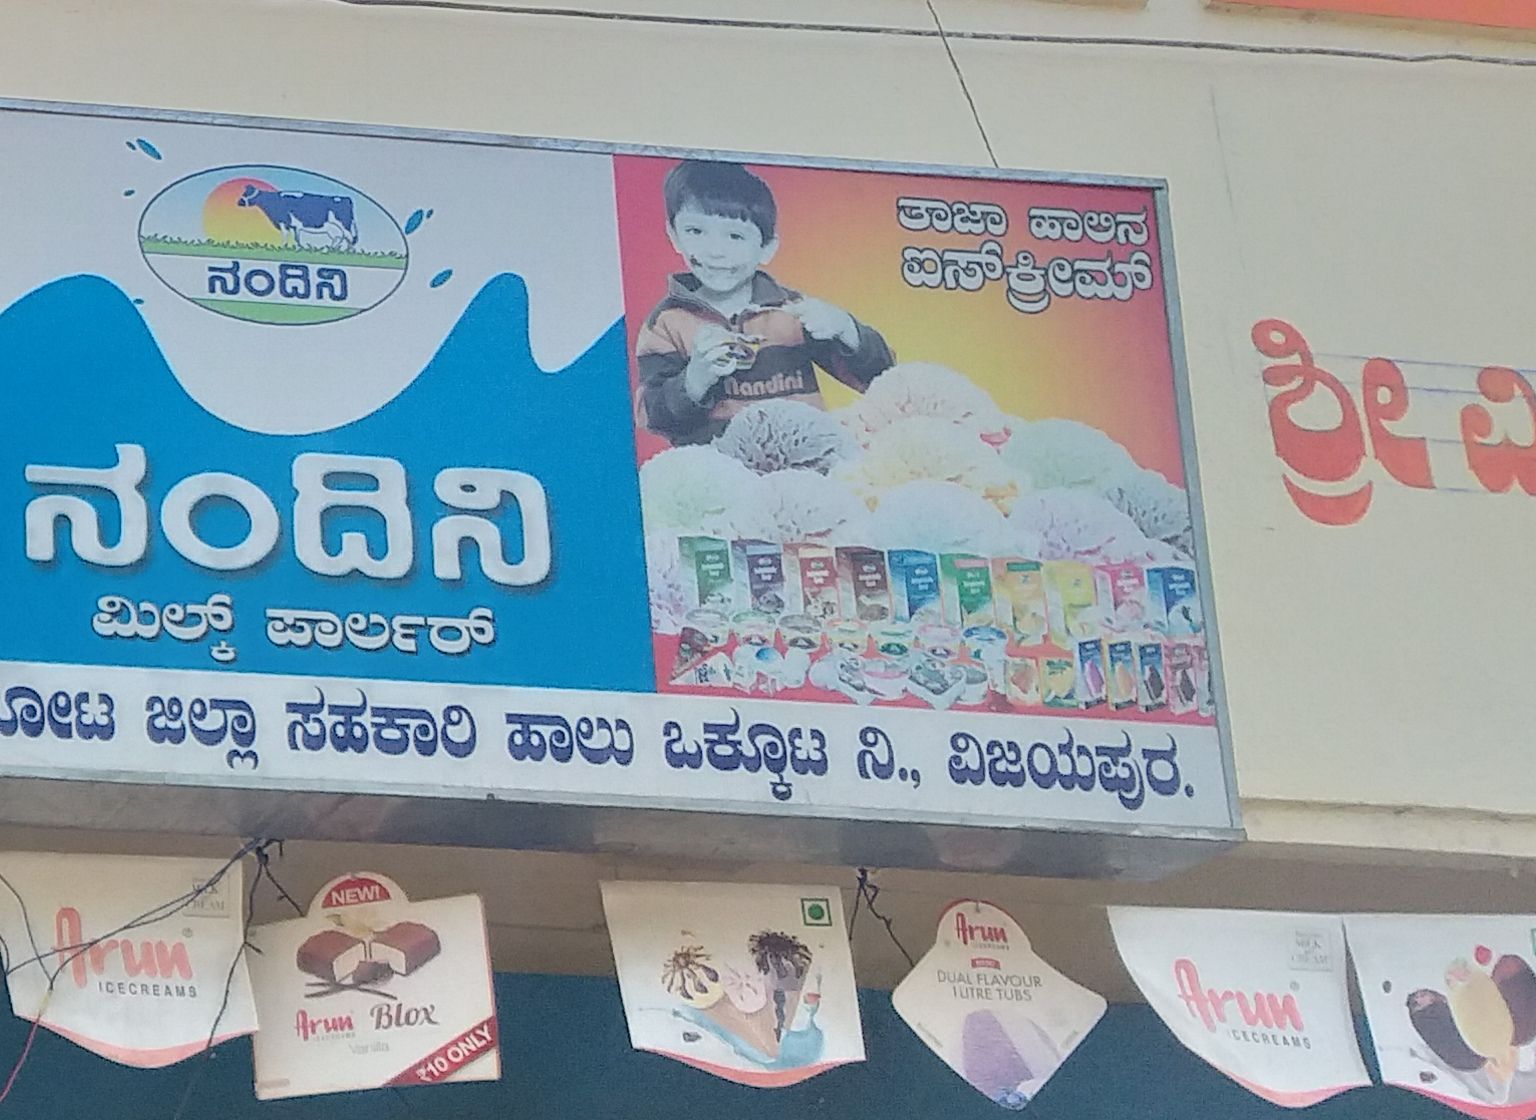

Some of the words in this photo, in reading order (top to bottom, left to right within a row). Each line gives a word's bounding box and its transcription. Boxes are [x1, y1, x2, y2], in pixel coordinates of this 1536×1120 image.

[896, 196, 1008, 237] ತಾಜಾ
[1028, 203, 1149, 245] ಹಾಲಿನ
[206, 260, 349, 302] ನಂದಿನಿ
[1251, 318, 1438, 526] ಶ್ರೀ
[24, 442, 554, 588] ನಂದಿನಿ
[91, 594, 237, 662] ಮಿಲ್ಕ್
[265, 606, 495, 656] ಪಾರ್ಲರ್
[144, 693, 259, 771] ಜಿಲ್ಲಾ
[285, 686, 478, 761] ಸಹಕಾರಿ
[505, 709, 636, 767] ಹಾಲು
[662, 707, 828, 801] ಒಕ್ಕೂಟ
[330, 885, 382, 908] NEW!
[54, 906, 194, 989] Arun
[955, 912, 1008, 946] Arun
[97, 981, 198, 998] ICECREAMS
[937, 969, 973, 985] DUAL
[976, 973, 1043, 988] FLAVOUR
[959, 986, 993, 1001] LITRE
[995, 988, 1032, 1002] TUBS
[1174, 957, 1305, 1032] Arun
[295, 1009, 354, 1041] Arun
[370, 1002, 440, 1031] Blox
[1226, 1030, 1312, 1050] ICECREAMS
[446, 1024, 494, 1064] ONLY
